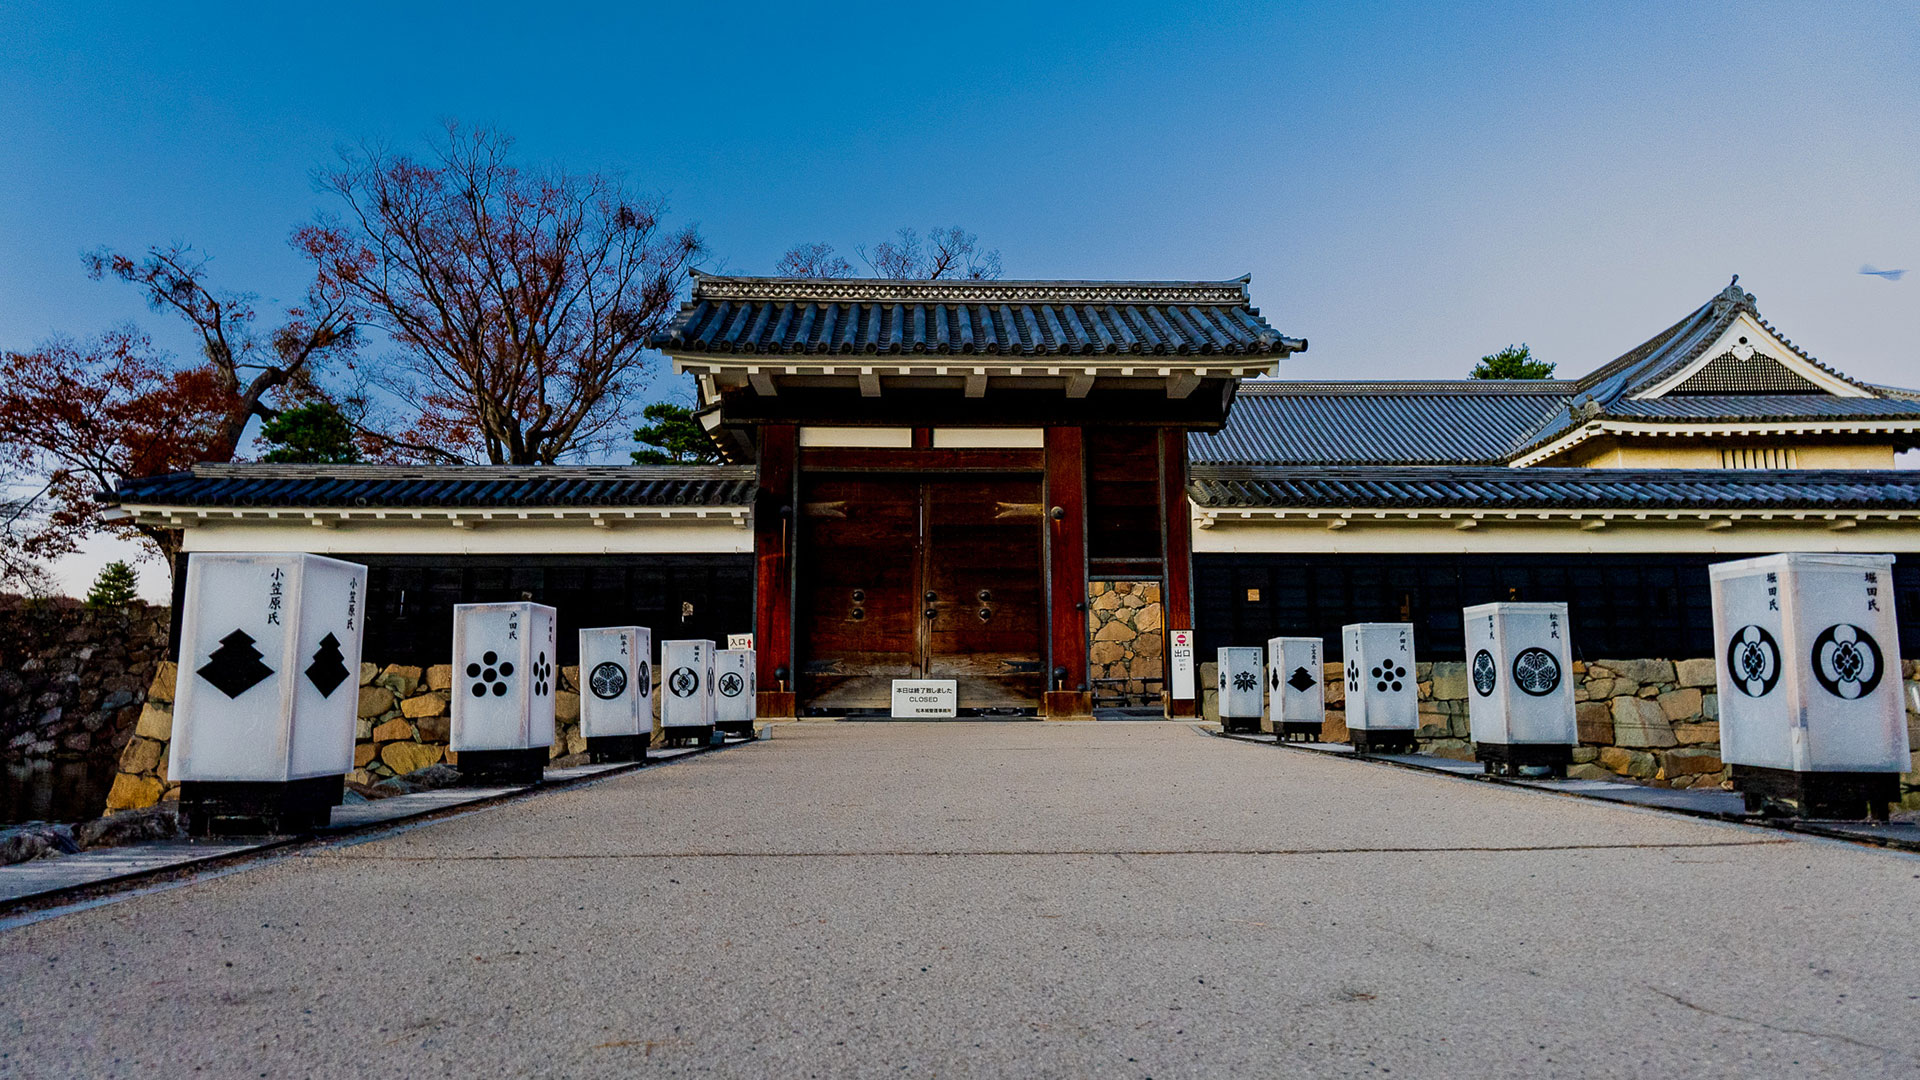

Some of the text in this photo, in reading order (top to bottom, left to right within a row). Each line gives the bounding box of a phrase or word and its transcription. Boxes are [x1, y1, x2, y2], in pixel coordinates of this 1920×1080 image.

[267, 567, 284, 626] 小笠原氏
[1864, 571, 1880, 612] 堀田氏
[1549, 612, 1559, 640] 松平氏
[730, 638, 746, 647] 入口
[1174, 649, 1191, 658] 出口
